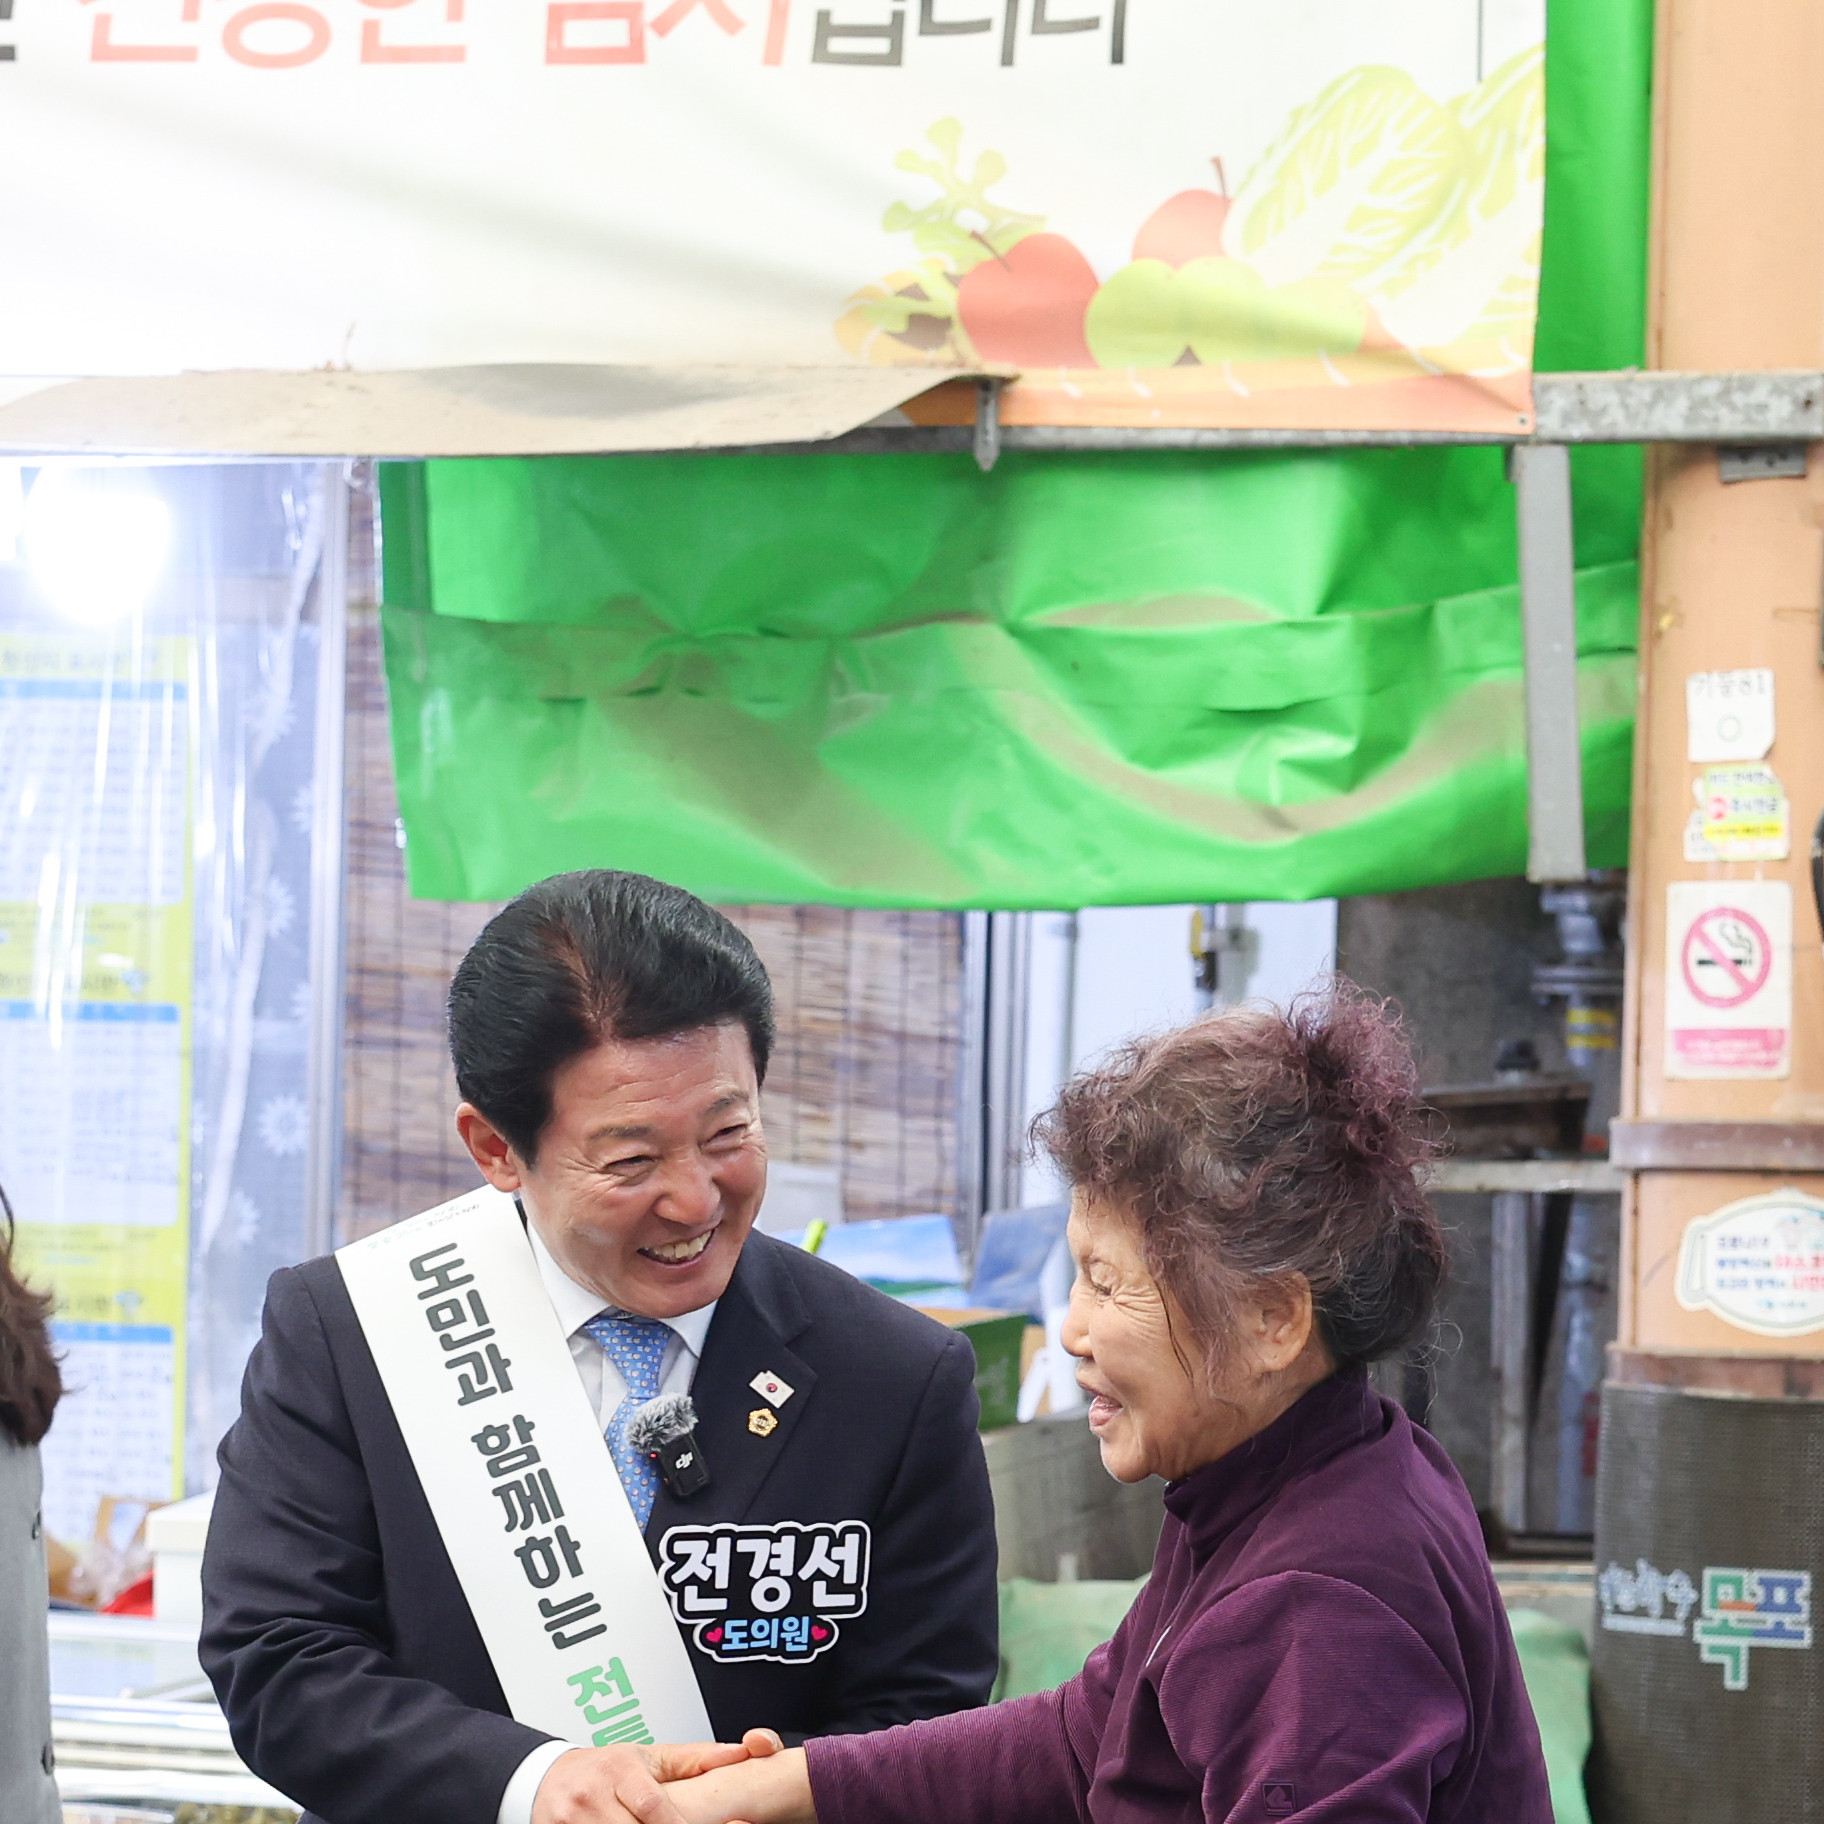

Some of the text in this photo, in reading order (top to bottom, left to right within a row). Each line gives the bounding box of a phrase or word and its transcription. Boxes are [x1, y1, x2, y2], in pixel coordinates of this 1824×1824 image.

[408, 1241, 516, 1407] 도민과
[470, 1413, 608, 1651] 함께하는
[670, 1532, 861, 1614] 전경선
[721, 1615, 811, 1653] 도의원
